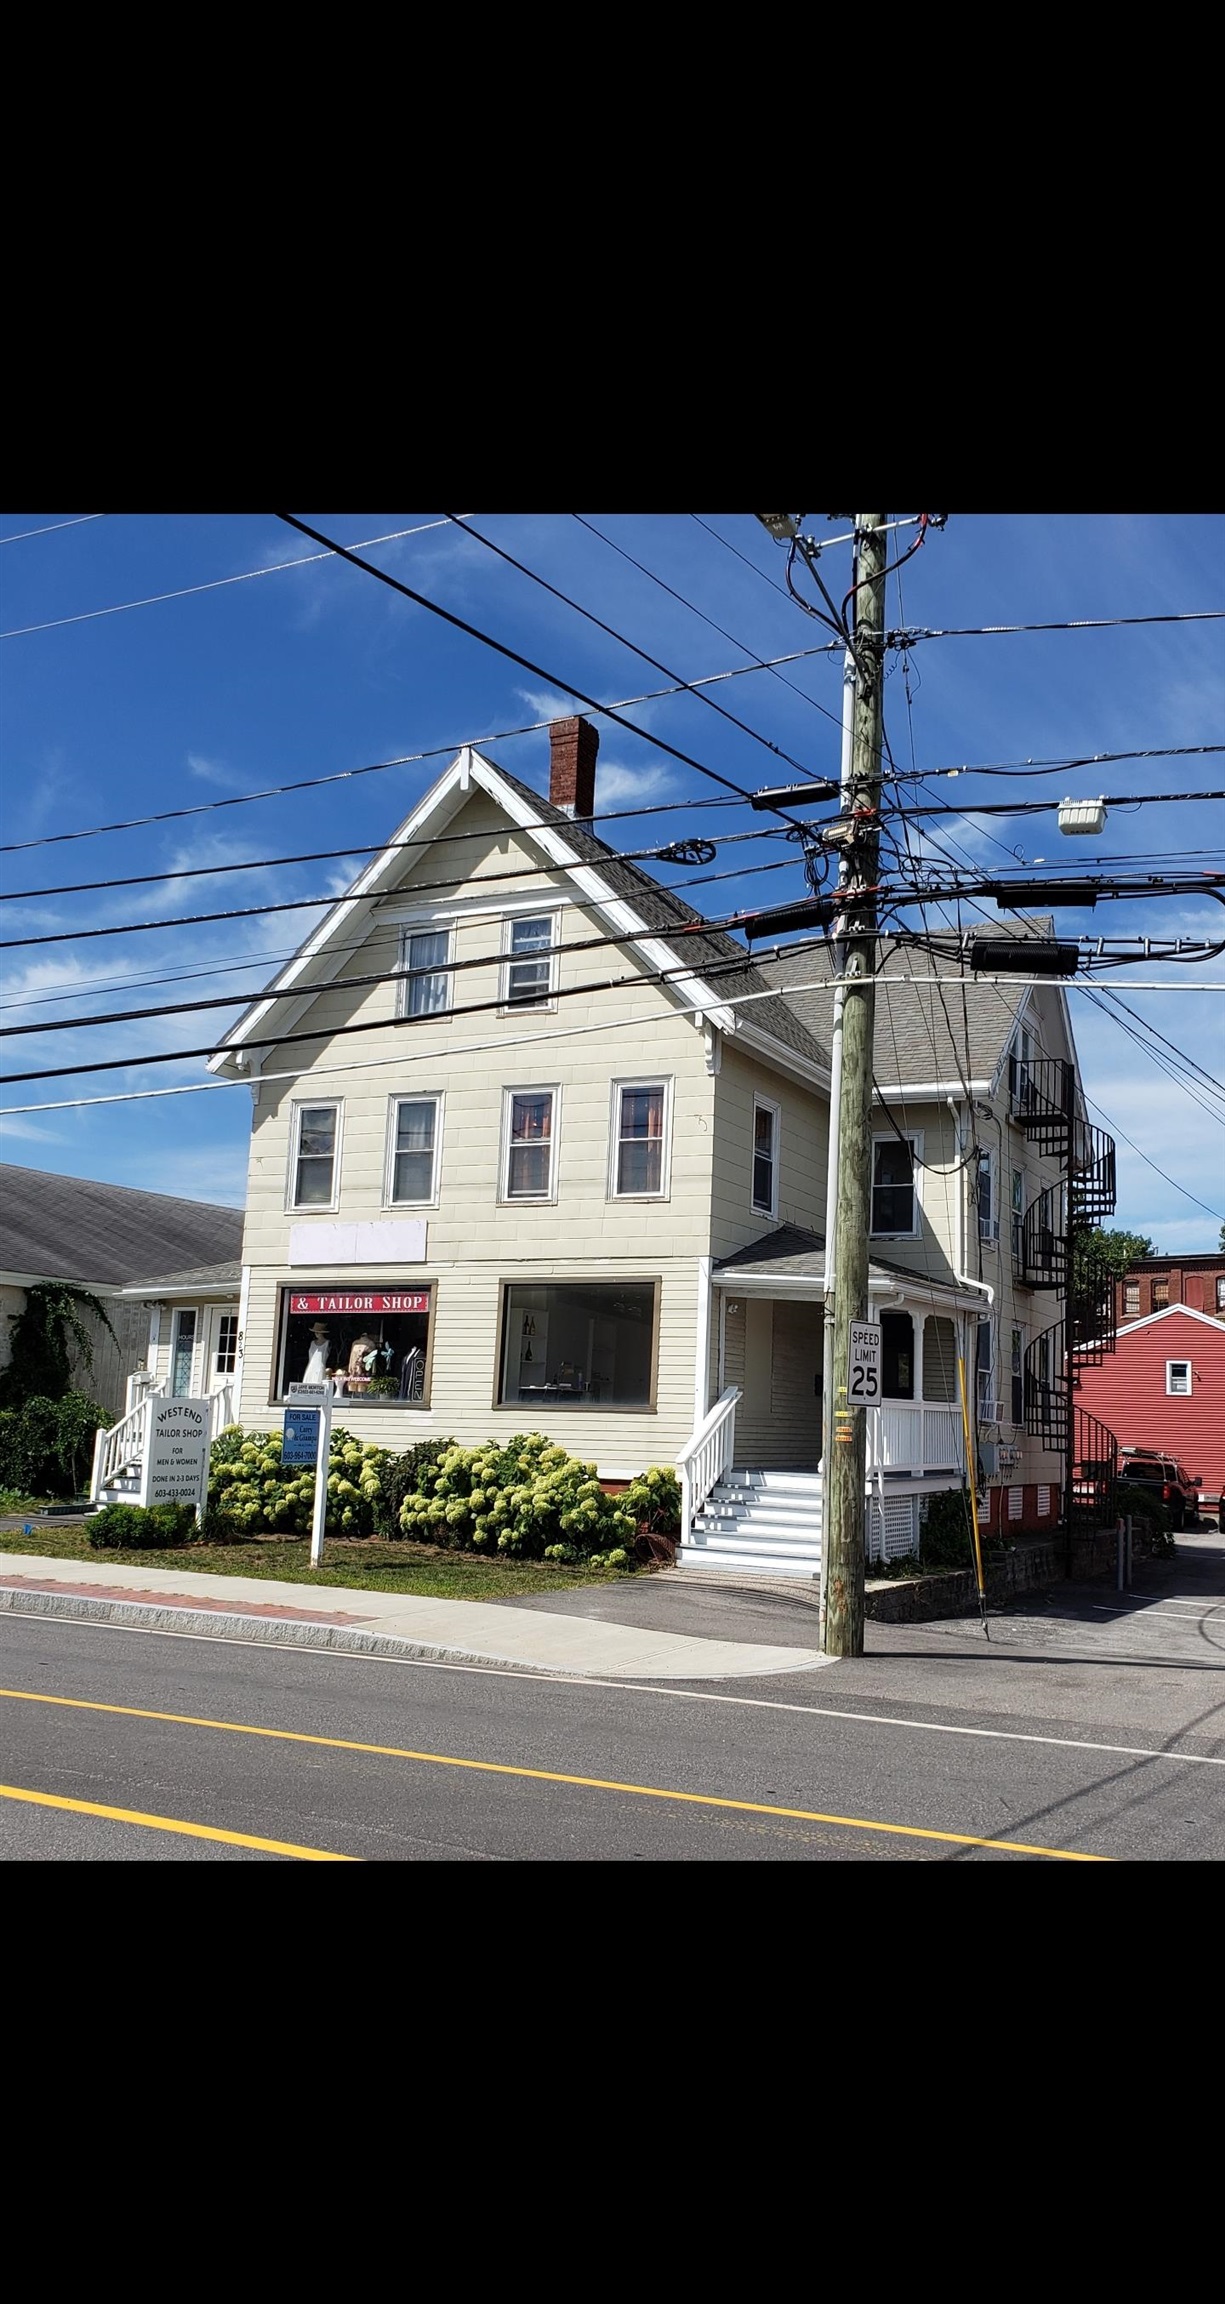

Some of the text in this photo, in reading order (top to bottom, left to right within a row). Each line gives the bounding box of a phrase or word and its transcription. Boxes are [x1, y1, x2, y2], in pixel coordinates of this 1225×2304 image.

[297, 1296, 422, 1309] & TAILOR SHOP
[852, 1331, 879, 1346] SPEED
[855, 1349, 876, 1362] LIMIT
[415, 1360, 424, 1399] OPEN
[851, 1365, 878, 1397] 25
[157, 1407, 202, 1424] WEST END
[156, 1429, 203, 1438] TAILOR SHOP
[154, 1488, 195, 1497] 603-433-0024
